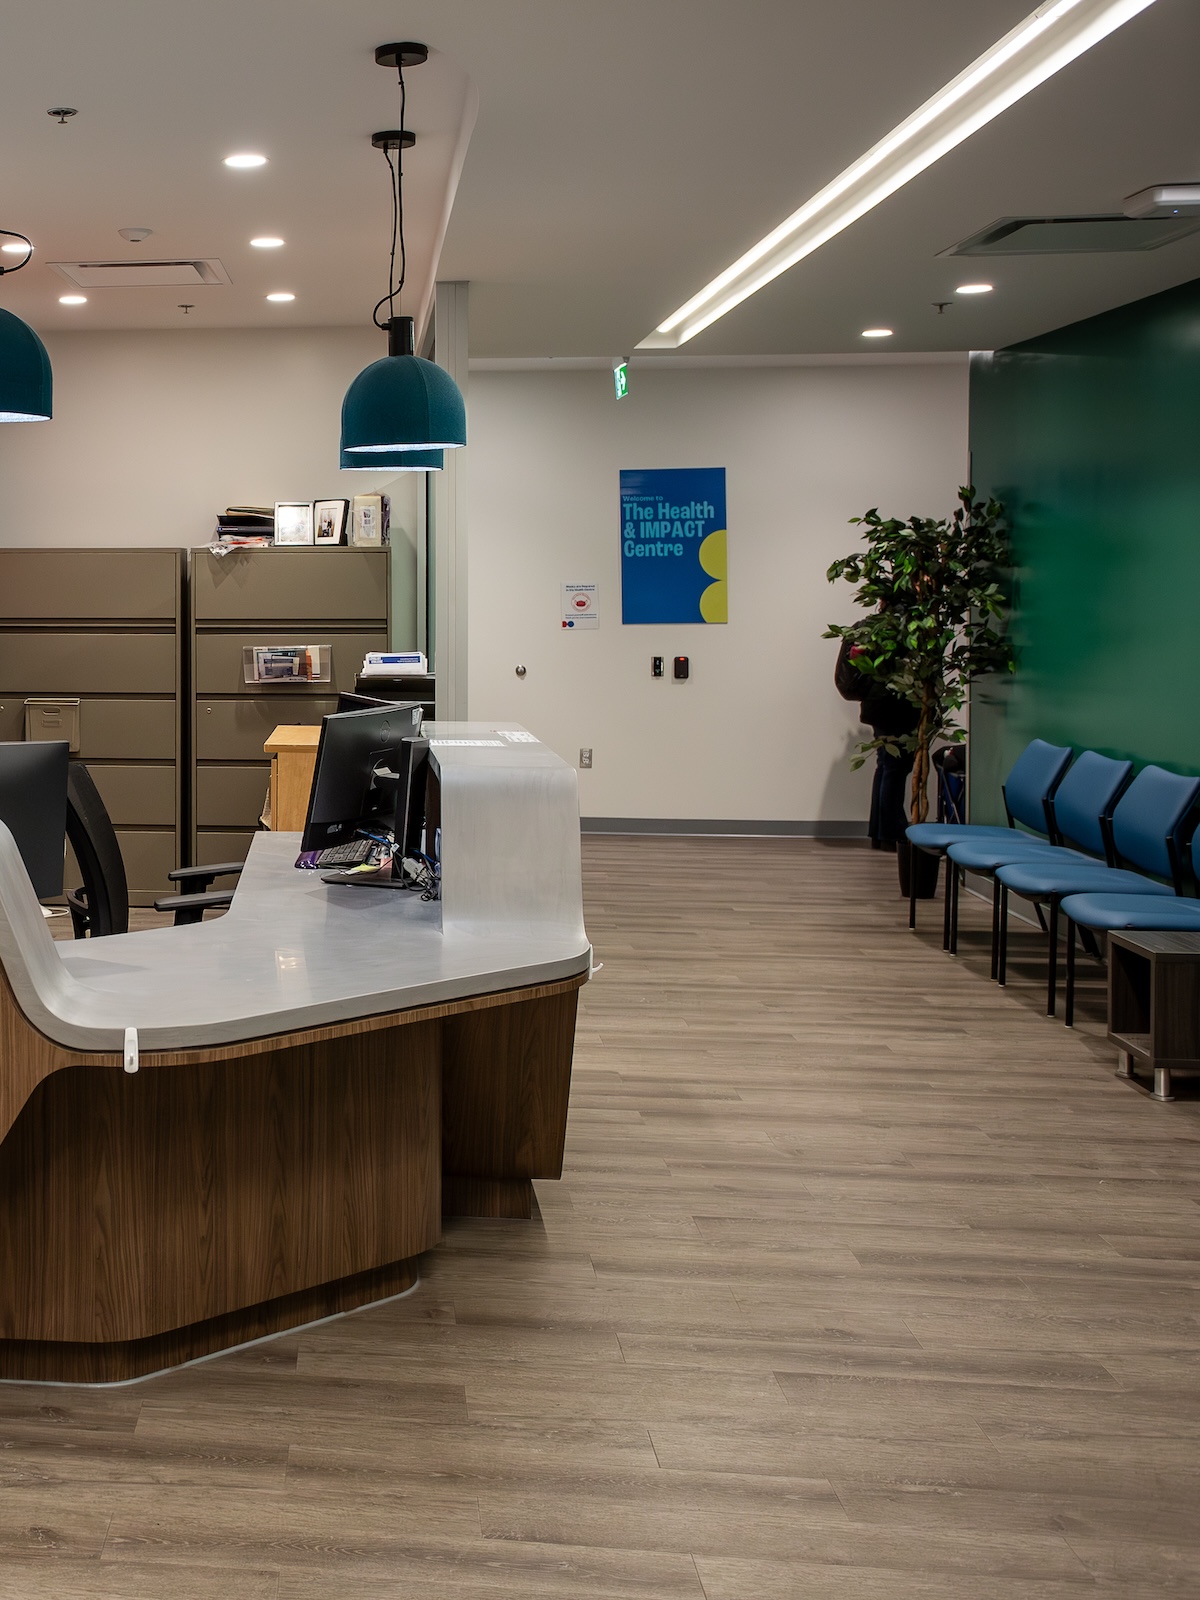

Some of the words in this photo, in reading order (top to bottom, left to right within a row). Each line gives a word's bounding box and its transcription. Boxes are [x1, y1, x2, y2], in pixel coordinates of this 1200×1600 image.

[622, 502, 654, 520] The
[657, 500, 715, 519] Health
[623, 521, 636, 539] &
[639, 520, 705, 539] IMPACT
[623, 539, 684, 558] Centre
